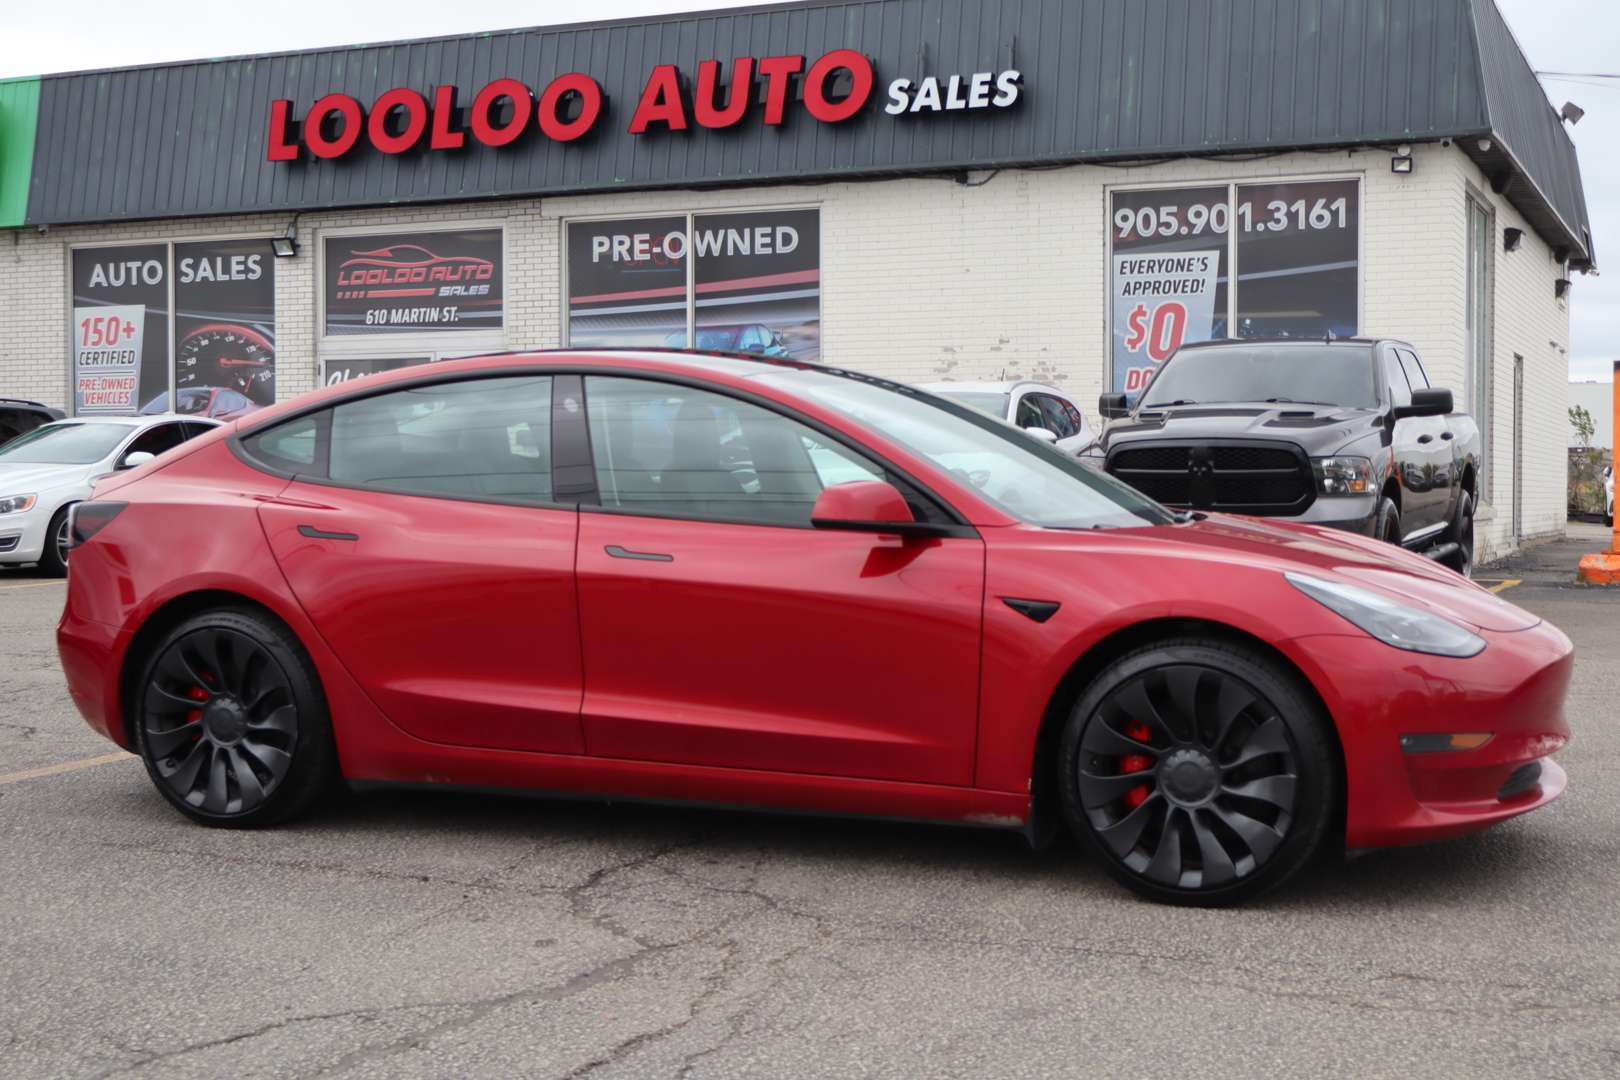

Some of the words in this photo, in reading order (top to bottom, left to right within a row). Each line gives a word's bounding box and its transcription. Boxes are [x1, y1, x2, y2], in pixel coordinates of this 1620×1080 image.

[267, 72, 601, 160] LOOLOO
[627, 49, 873, 134] AUTO
[884, 70, 1020, 115] SALES
[1114, 197, 1347, 238] 905.901.3161
[592, 226, 799, 263] PRE-OWNED
[89, 260, 163, 287] AUTO
[180, 254, 262, 283] SALES
[337, 268, 427, 285] LOOLOO
[429, 264, 494, 281] AUTO
[1120, 257, 1208, 275] EVERYONE'S
[439, 285, 490, 296] SALES
[1122, 279, 1205, 296] APPROVED!
[366, 309, 387, 324] 610
[390, 307, 439, 324] MARTIN
[442, 306, 459, 321] ST.
[80, 316, 135, 347] 150+
[1125, 302, 1187, 361] $0
[79, 350, 135, 366] CERTIFIED
[79, 377, 135, 390] PRE-OWNED
[84, 391, 130, 405] VEHICLES
